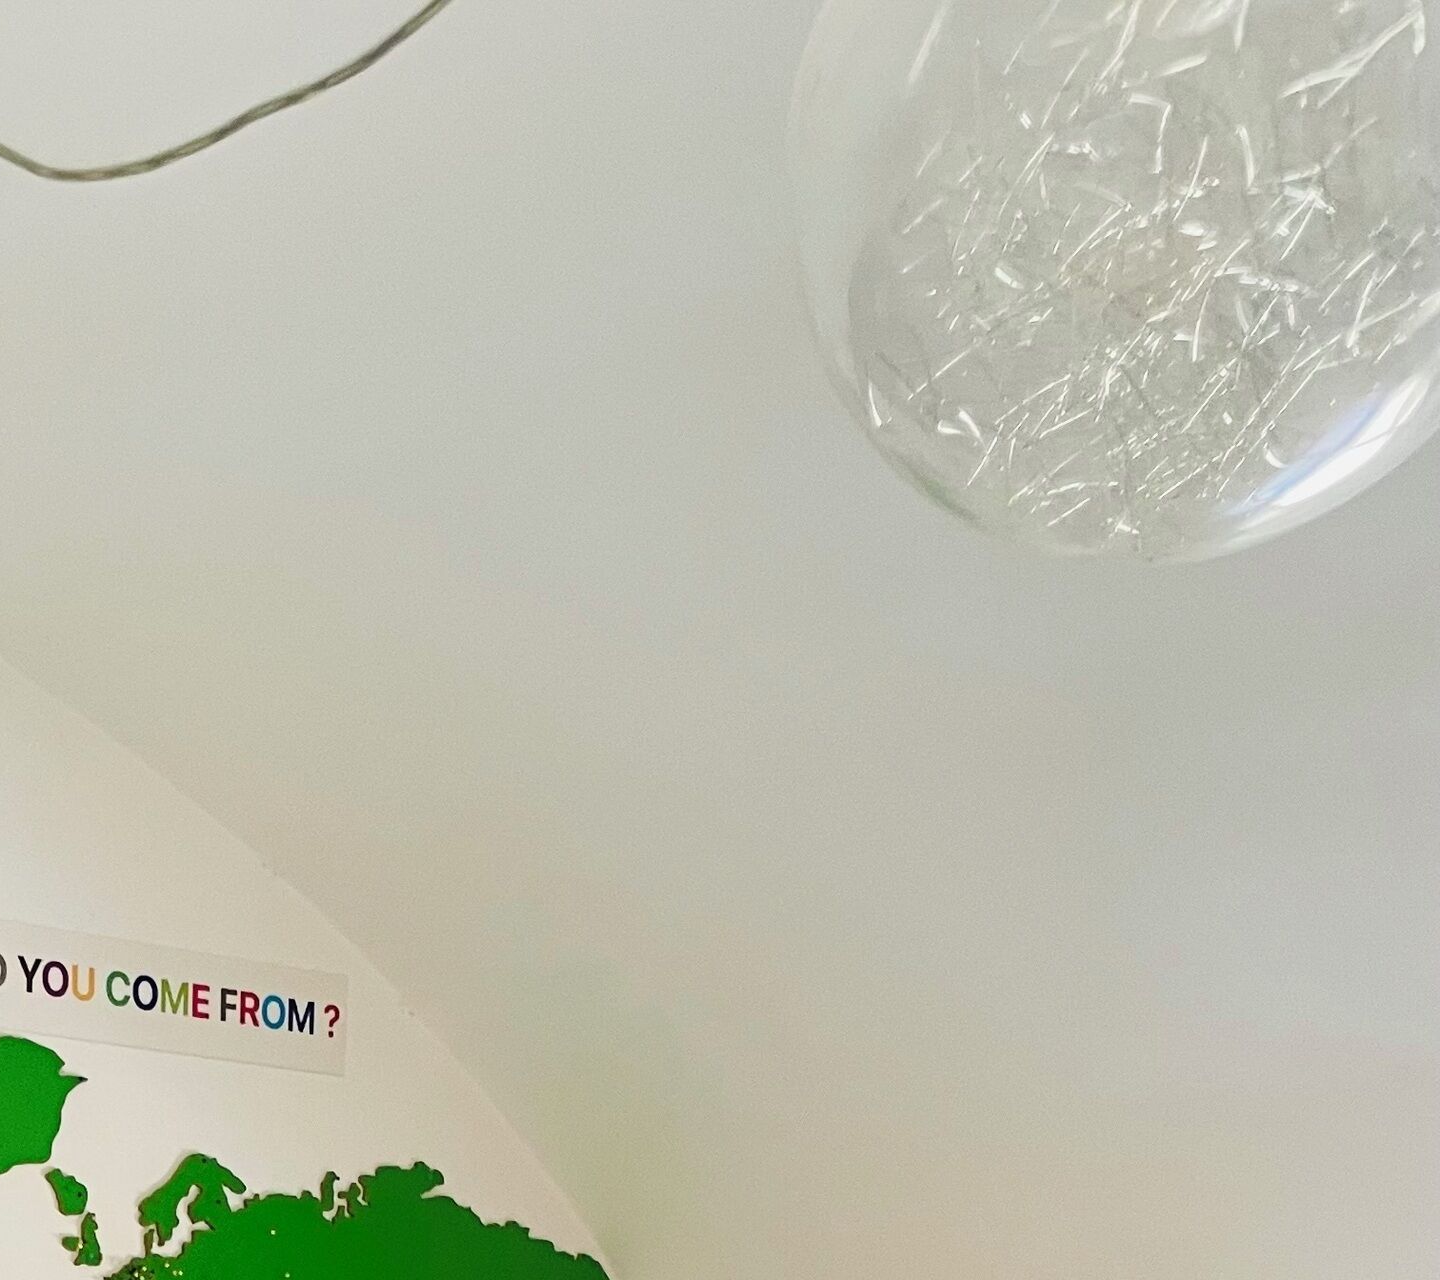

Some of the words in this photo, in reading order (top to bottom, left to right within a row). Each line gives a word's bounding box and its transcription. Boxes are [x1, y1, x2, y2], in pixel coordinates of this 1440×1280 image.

[17, 955, 96, 1002] YOU
[105, 970, 211, 1019] COME
[219, 988, 316, 1035] FROM
[323, 1004, 340, 1038] ?
